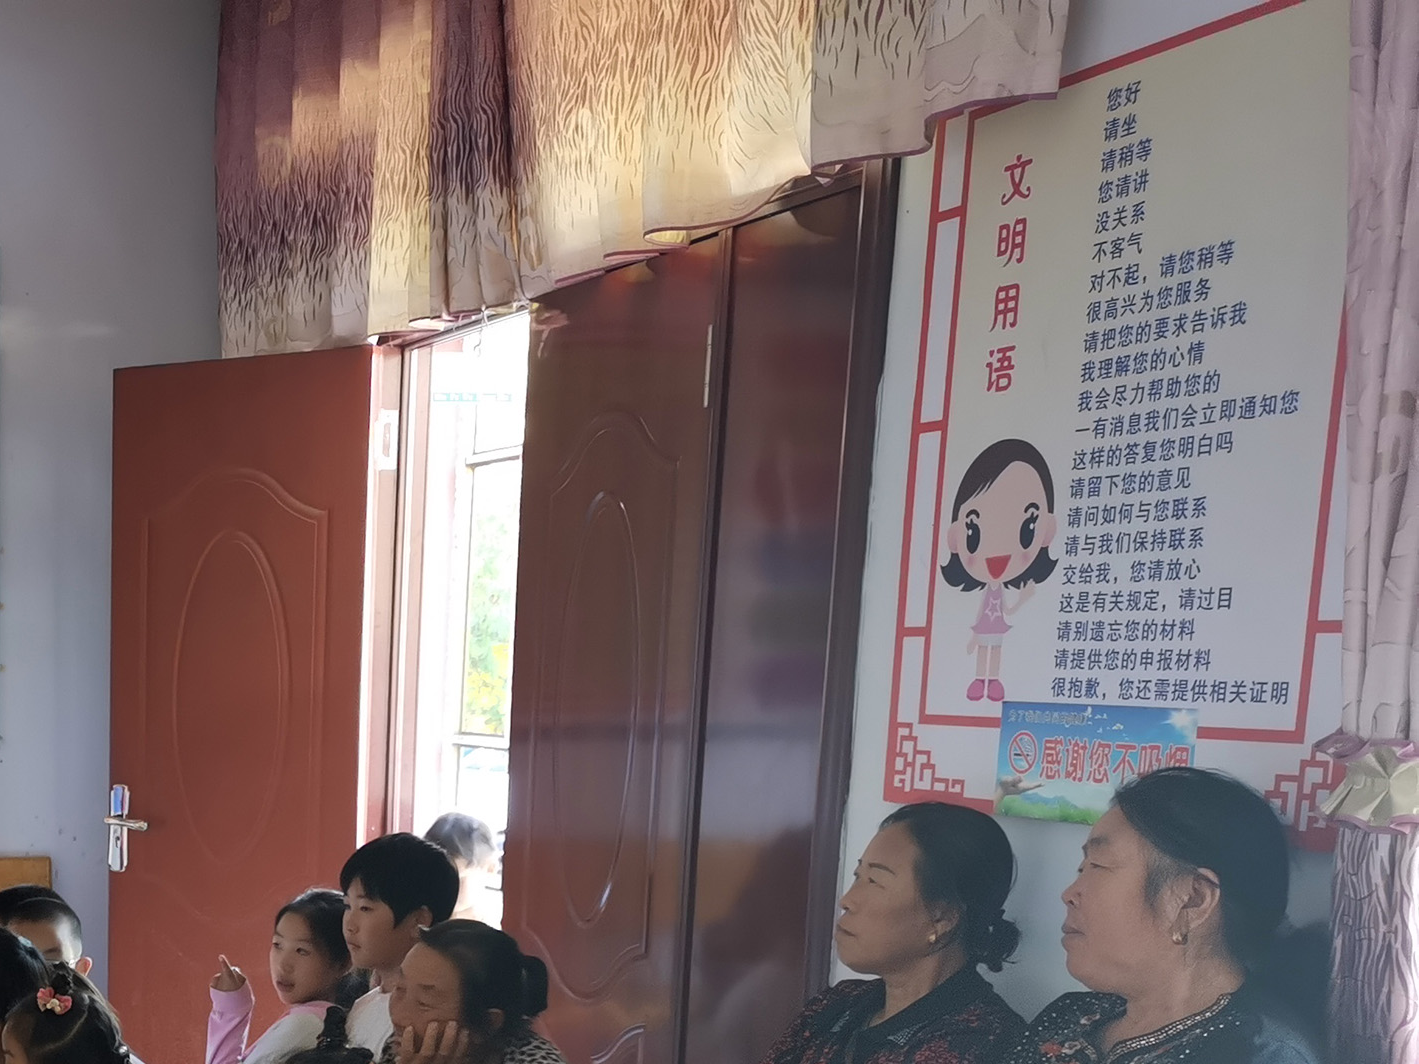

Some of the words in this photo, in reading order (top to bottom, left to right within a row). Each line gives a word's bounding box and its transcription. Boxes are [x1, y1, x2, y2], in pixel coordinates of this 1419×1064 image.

[1106, 80, 1142, 112] 您好
[1103, 113, 1137, 143] 请坐
[1100, 137, 1153, 173] 请稍等
[1098, 168, 1150, 204] 您请讲
[1094, 201, 1146, 234] 没关系
[1092, 232, 1144, 264] 不客气
[984, 153, 1035, 394] 文明用语
[1088, 239, 1236, 294] 对不起，请您稍等
[1085, 277, 1212, 325] 很高兴为您服务
[1083, 300, 1248, 355] 请把您的要求告诉我
[1080, 340, 1206, 384] 我理解您的心情
[1077, 369, 1221, 413] 我会尽力帮助您的
[1074, 389, 1300, 441] 一有消息我们会立即通知您
[1071, 430, 1234, 471] 这样的答复您明白吗
[1068, 466, 1192, 501] 请留下您的意见
[1066, 496, 1207, 529] 请问如何与您联系
[1064, 526, 1205, 557] 请与我们保持联系
[1061, 557, 1202, 586] 交给我，您请放心
[1058, 586, 1233, 614] 这是有关规定，请过目
[1056, 618, 1196, 642] 请别遗忘您的材料
[1053, 648, 1212, 672] 请提供您的申报材料
[1050, 676, 1290, 705] 很抱歉，您还需提供相关证明
